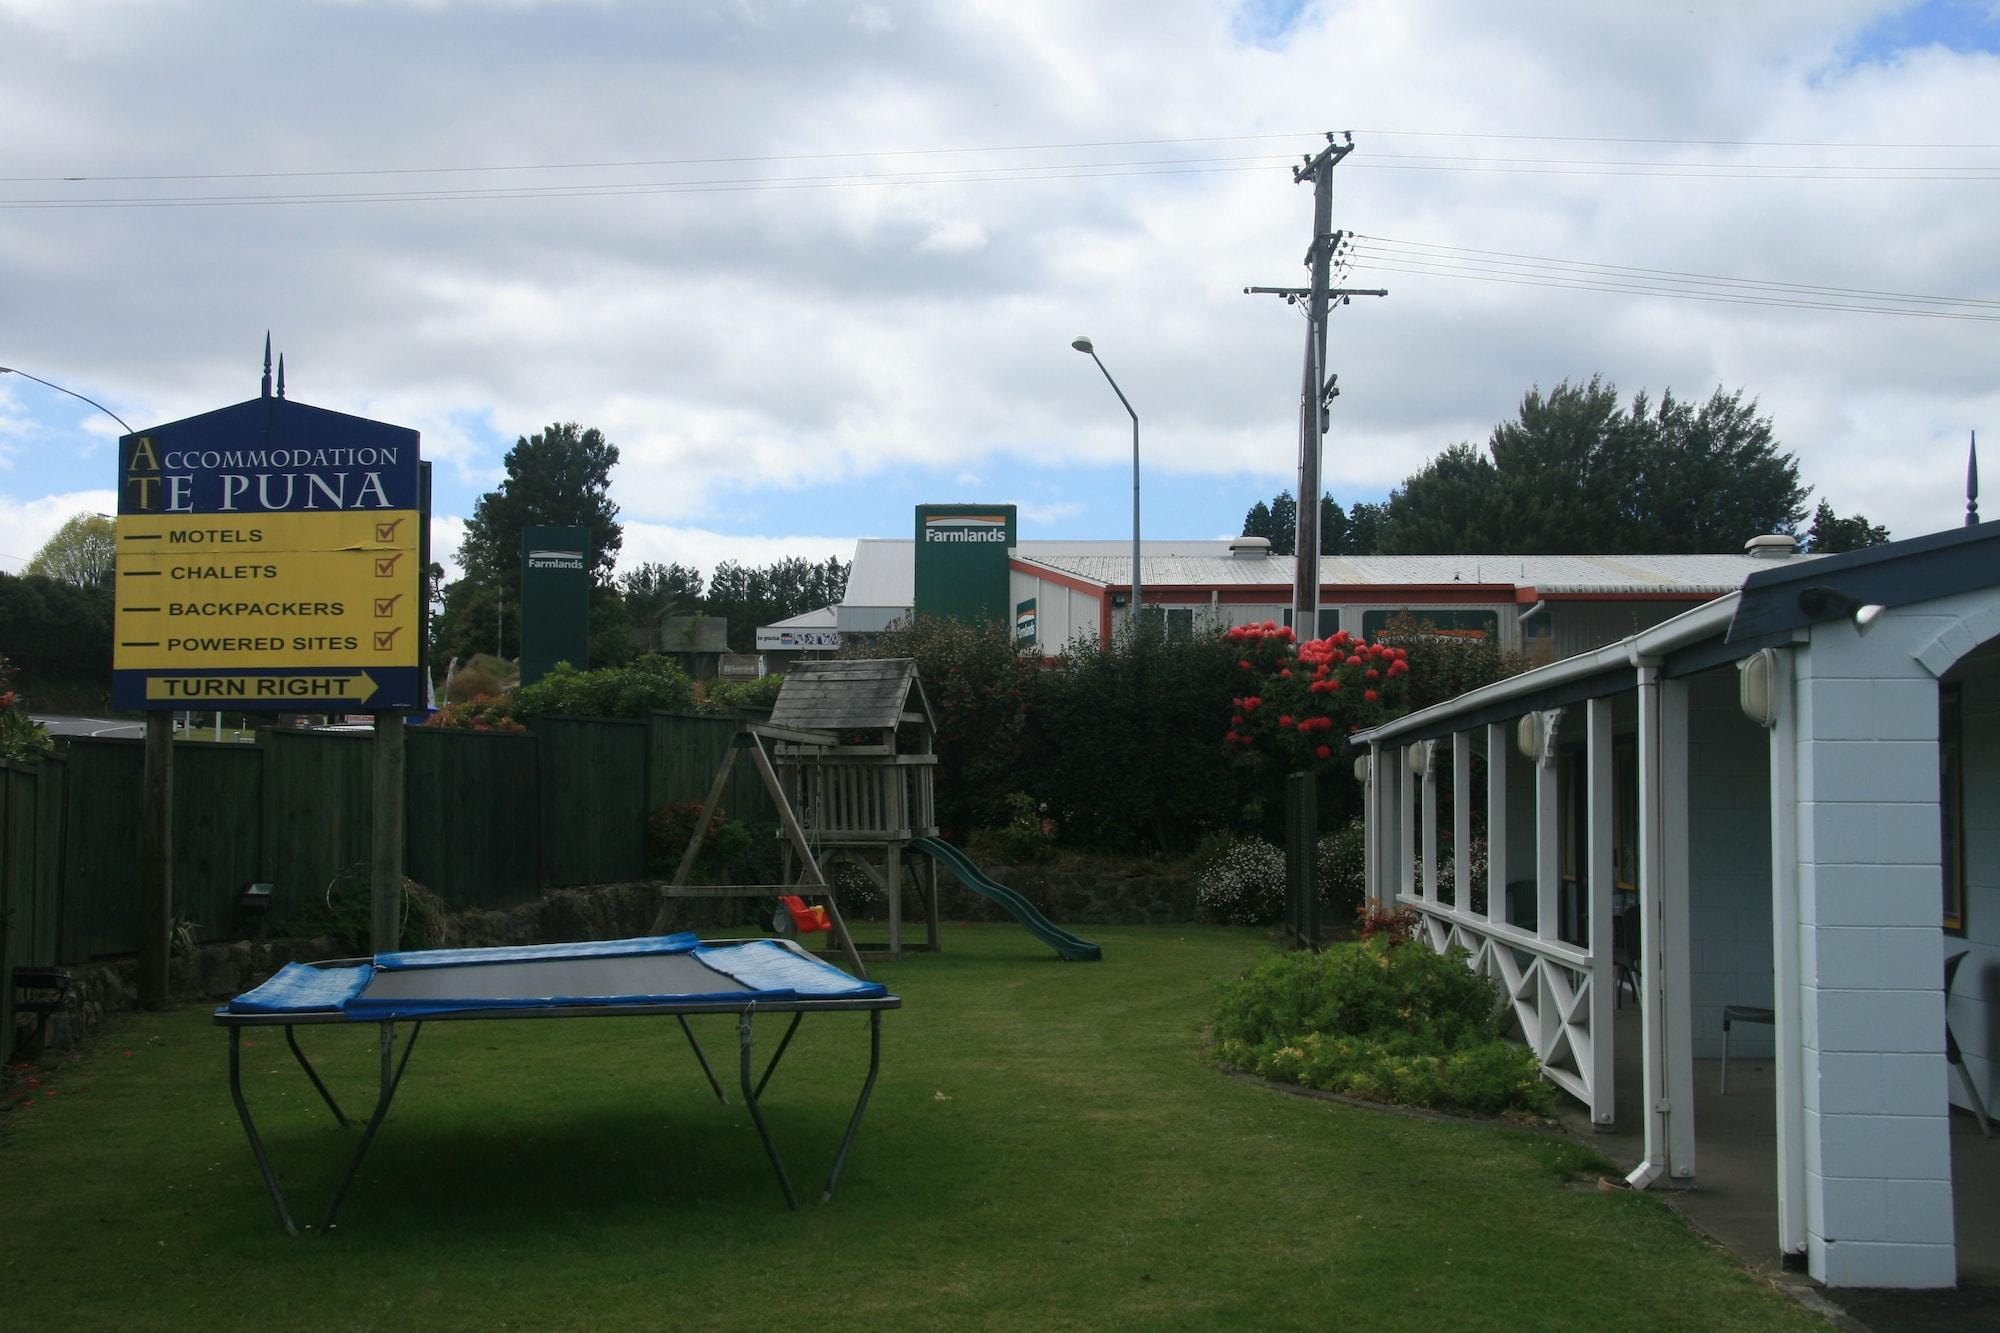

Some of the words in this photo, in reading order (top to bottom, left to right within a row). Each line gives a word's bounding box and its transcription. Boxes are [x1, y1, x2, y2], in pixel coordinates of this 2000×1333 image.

[128, 437, 398, 471] ACCOMMODATION
[128, 474, 194, 513] TE
[218, 471, 395, 511] PUNA
[169, 529, 263, 543] MOTELS
[926, 528, 1006, 543] Farmlands
[529, 558, 584, 569] Farmlands
[171, 566, 277, 580] CHALETS
[169, 603, 345, 616] BACKPACKERS
[168, 638, 285, 651] POWERED
[292, 636, 358, 650] SITES
[163, 679, 245, 696] TURN
[256, 679, 350, 696] RIGHT
